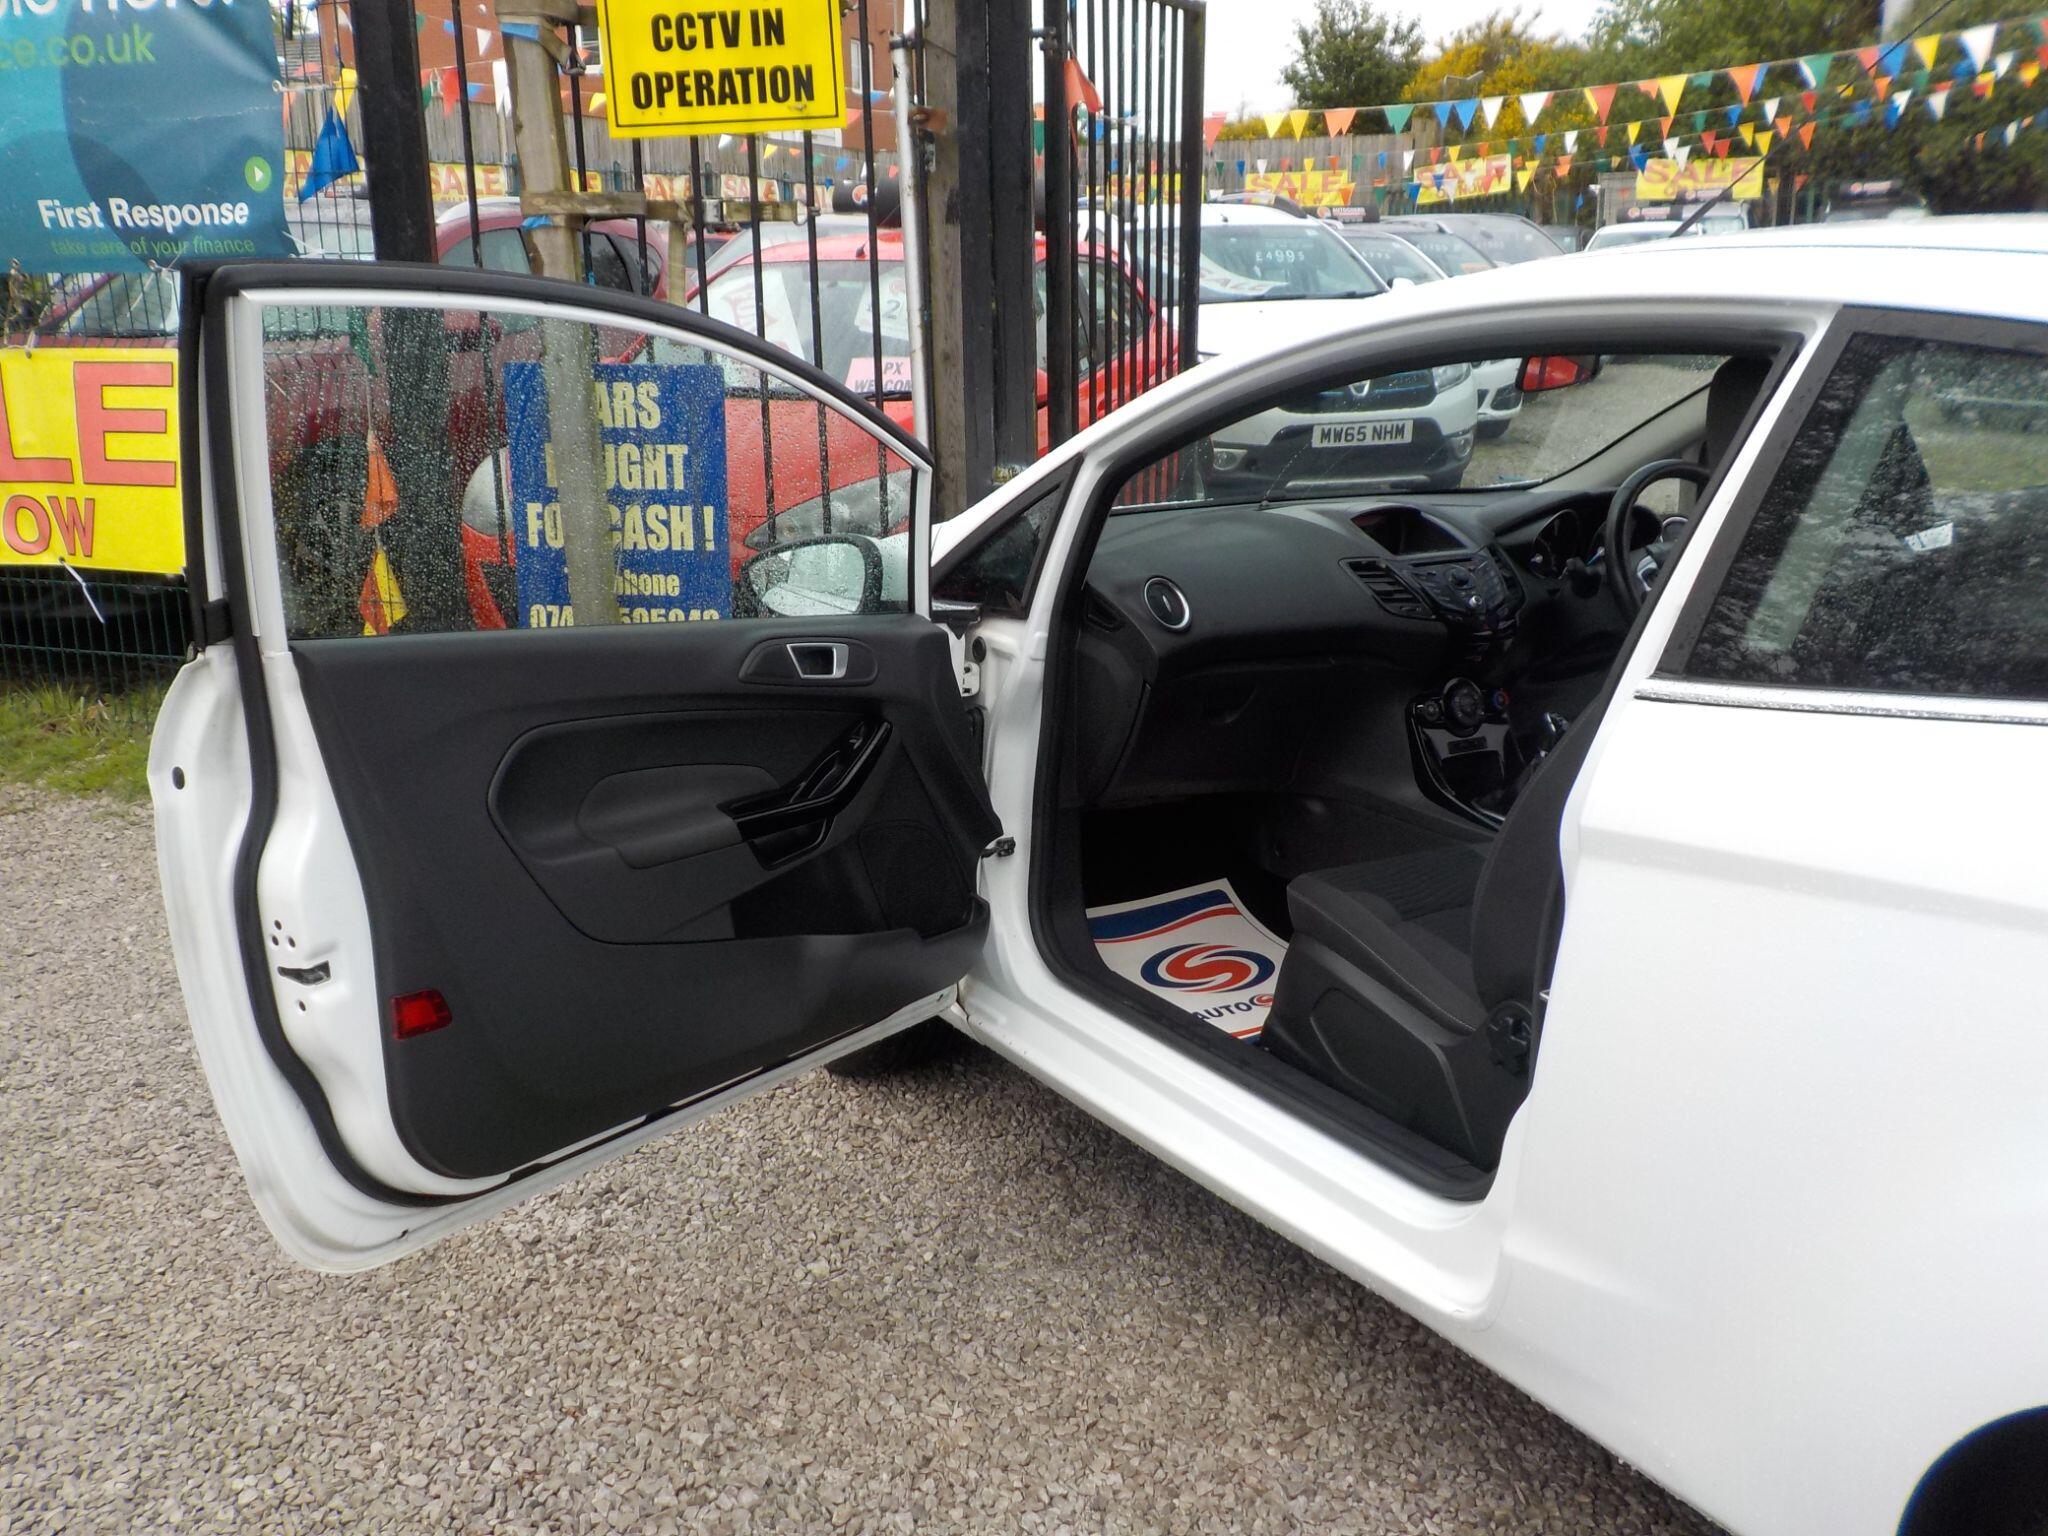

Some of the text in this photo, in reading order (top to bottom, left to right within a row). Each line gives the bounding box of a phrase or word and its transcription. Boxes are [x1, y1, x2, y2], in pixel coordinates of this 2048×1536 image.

[651, 8, 785, 52] CCTV IN
[631, 64, 814, 109] OPERATION
[37, 197, 249, 233] First Response
[52, 240, 88, 255] take
[131, 238, 149, 255] of
[152, 239, 187, 258] your
[193, 236, 256, 254] finance
[883, 361, 904, 375] PX
[595, 381, 661, 429] ARS
[1320, 423, 1405, 444] MW65 NHM
